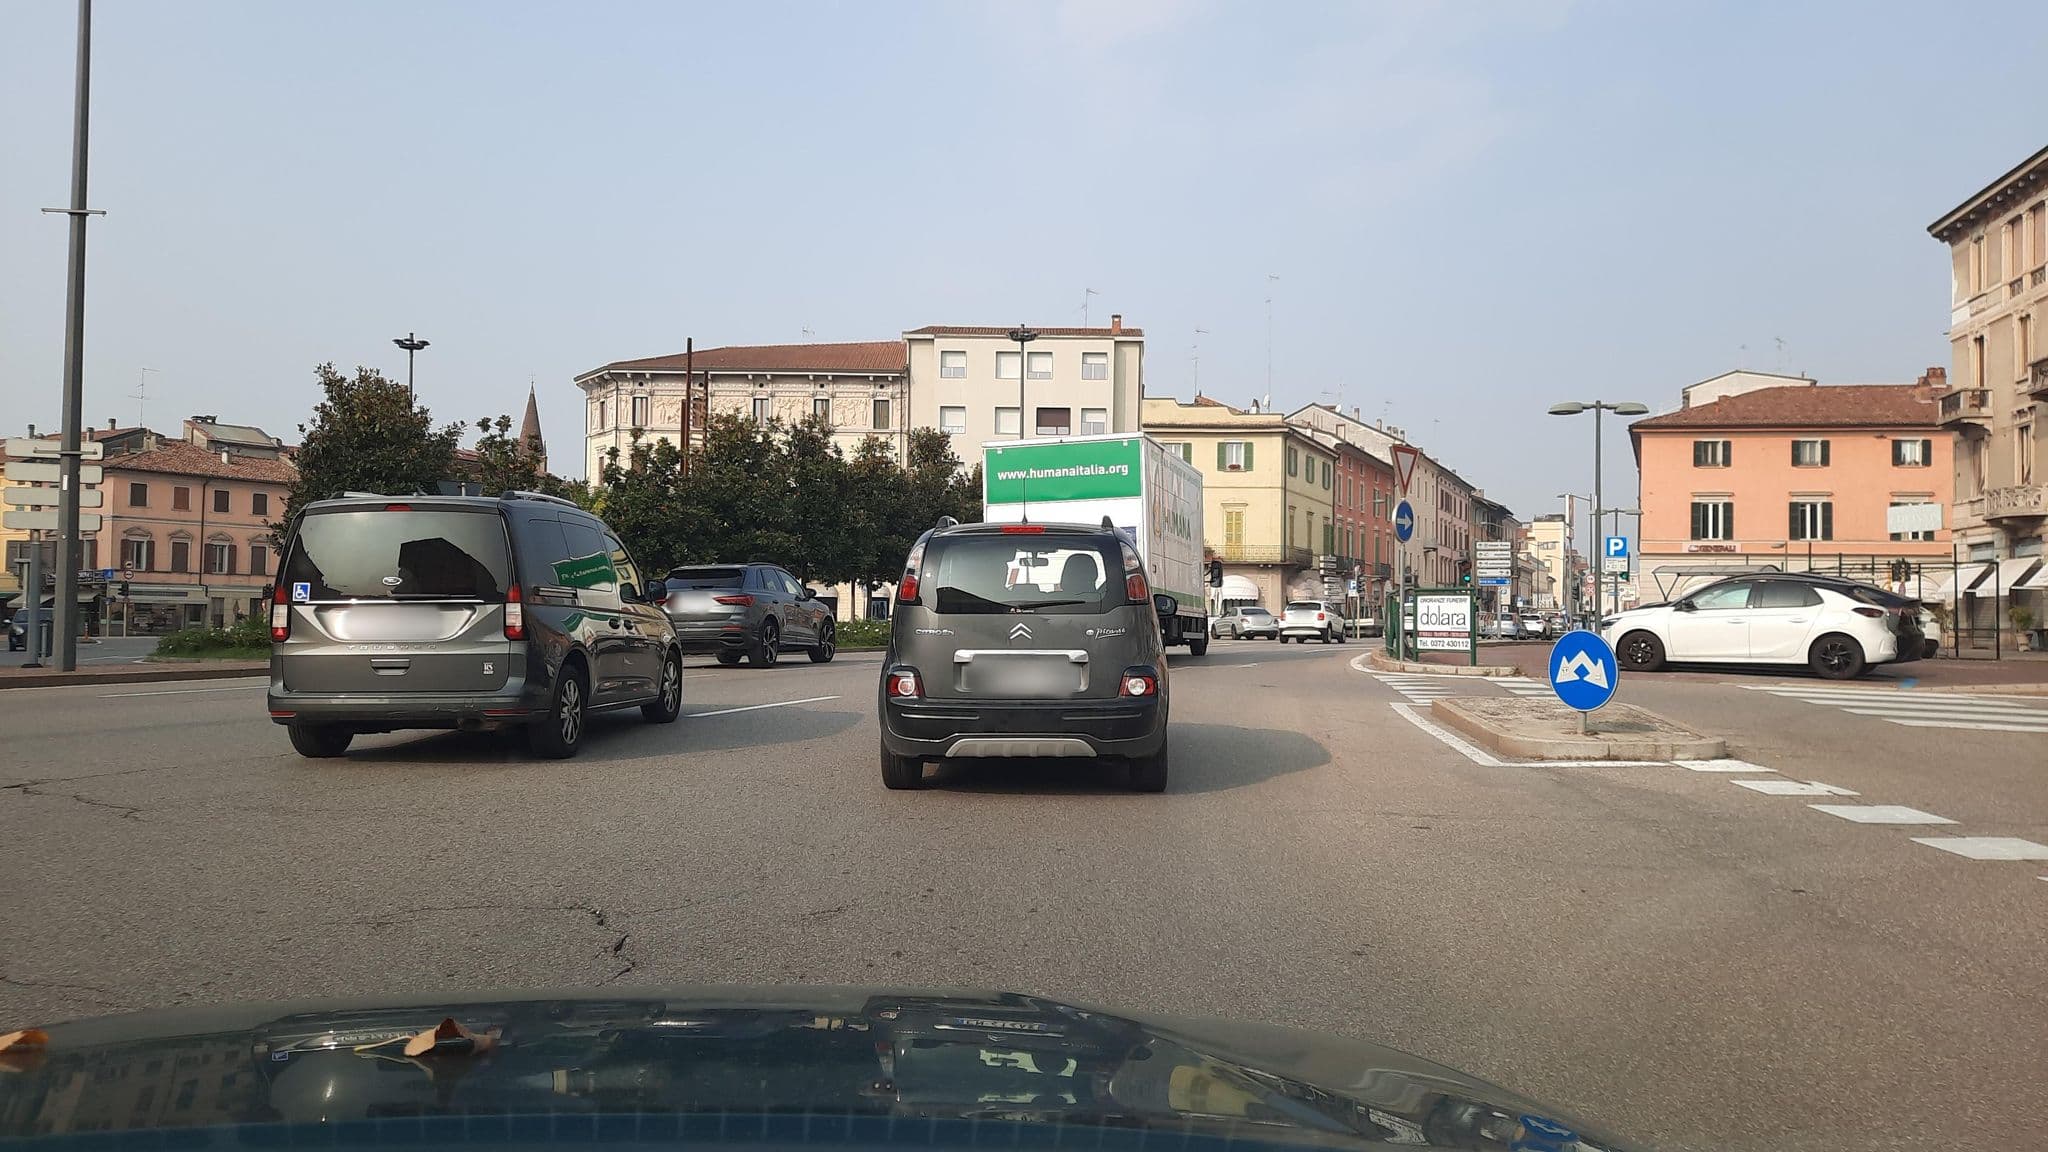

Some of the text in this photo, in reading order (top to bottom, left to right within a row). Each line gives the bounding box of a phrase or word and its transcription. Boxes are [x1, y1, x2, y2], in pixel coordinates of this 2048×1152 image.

[997, 463, 1129, 480] www.humanaitalia.org
[1609, 538, 1624, 556] P
[1420, 605, 1466, 626] dolara
[1446, 640, 1469, 648] 430112
